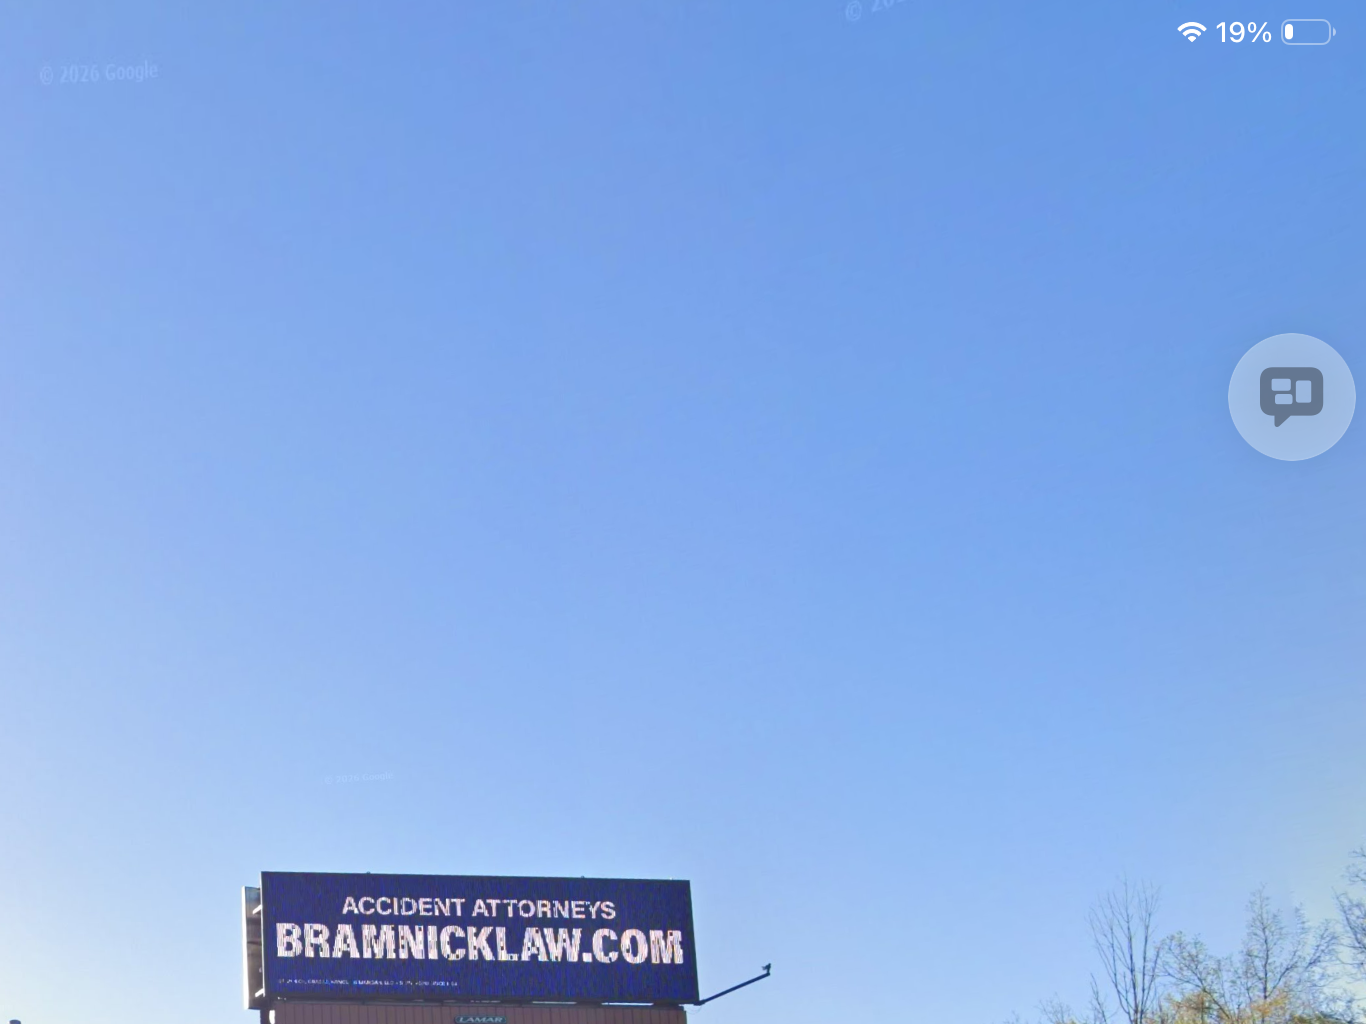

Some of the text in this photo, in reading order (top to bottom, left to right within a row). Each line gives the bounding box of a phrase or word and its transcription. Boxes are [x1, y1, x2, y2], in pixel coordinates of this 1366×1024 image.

[341, 895, 617, 920] ACCIDENT ATTORNEYS
[275, 921, 685, 965] BRAMNICKLAW.COM
